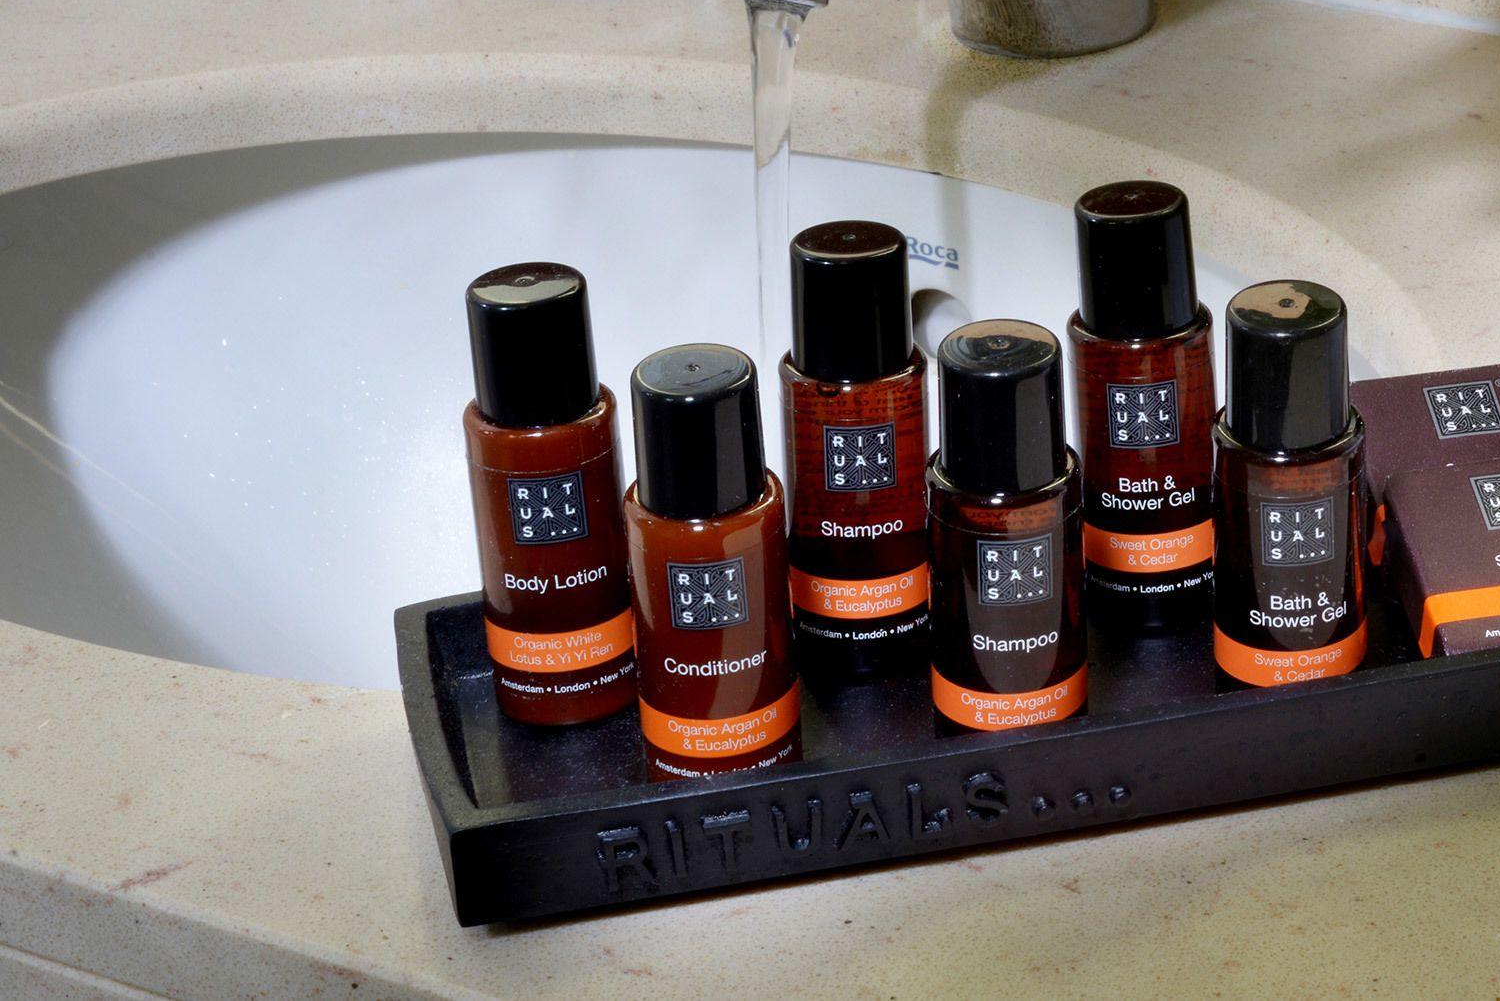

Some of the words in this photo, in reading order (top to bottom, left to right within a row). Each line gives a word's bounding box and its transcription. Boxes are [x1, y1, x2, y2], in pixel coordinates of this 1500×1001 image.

[907, 236, 958, 261] Roca
[1119, 477, 1158, 492] Bath
[1164, 475, 1176, 490] &
[1102, 492, 1164, 510] Shower
[1169, 487, 1195, 506] Gel
[821, 520, 903, 539] Shampoo
[1110, 537, 1146, 550] Sweet
[1150, 534, 1194, 550] Orange
[1128, 555, 1136, 566] &
[1140, 553, 1178, 566] Cedar
[504, 574, 548, 594] Body
[555, 566, 607, 589] Lotion
[811, 580, 856, 597] Organic
[860, 583, 896, 598] Argan
[900, 576, 913, 589] Oil
[1140, 584, 1174, 593] London
[1184, 576, 1201, 588] New
[1202, 571, 1214, 580] Yor
[824, 598, 832, 610] &
[836, 596, 902, 613] Eucalyptus
[1270, 595, 1311, 610] Bath
[1318, 592, 1330, 606] &
[1250, 610, 1317, 628] Shower
[1322, 601, 1346, 622] Gel
[852, 629, 887, 640] London
[897, 622, 914, 634] New
[514, 637, 562, 652] Organic
[566, 632, 602, 647] White
[973, 631, 1058, 652] Shampoo
[510, 650, 542, 665] Lotus
[546, 654, 554, 665] &
[558, 653, 571, 664] Yi
[575, 650, 587, 662] Yi
[590, 643, 613, 659] Ren
[664, 650, 767, 676] Conditioner
[1255, 653, 1294, 667] Sweet
[1298, 648, 1342, 666] Orange
[501, 677, 544, 693] Amsterdam
[554, 682, 591, 693] London
[600, 673, 618, 684] New
[619, 662, 634, 676] York
[1274, 671, 1283, 682] &
[1287, 668, 1325, 681] Cedar
[961, 693, 1010, 710] Organic
[1014, 694, 1051, 710] Argan
[1054, 685, 1068, 700] Oil
[668, 720, 717, 737] Organic
[721, 717, 760, 734] Argan
[762, 707, 777, 723] Oil
[975, 711, 984, 723] &
[988, 708, 1057, 726] Eucalyptus
[683, 739, 692, 750] &
[696, 731, 766, 751] Eucalyptus
[656, 759, 700, 777] Amsterdam
[758, 756, 777, 768] New
